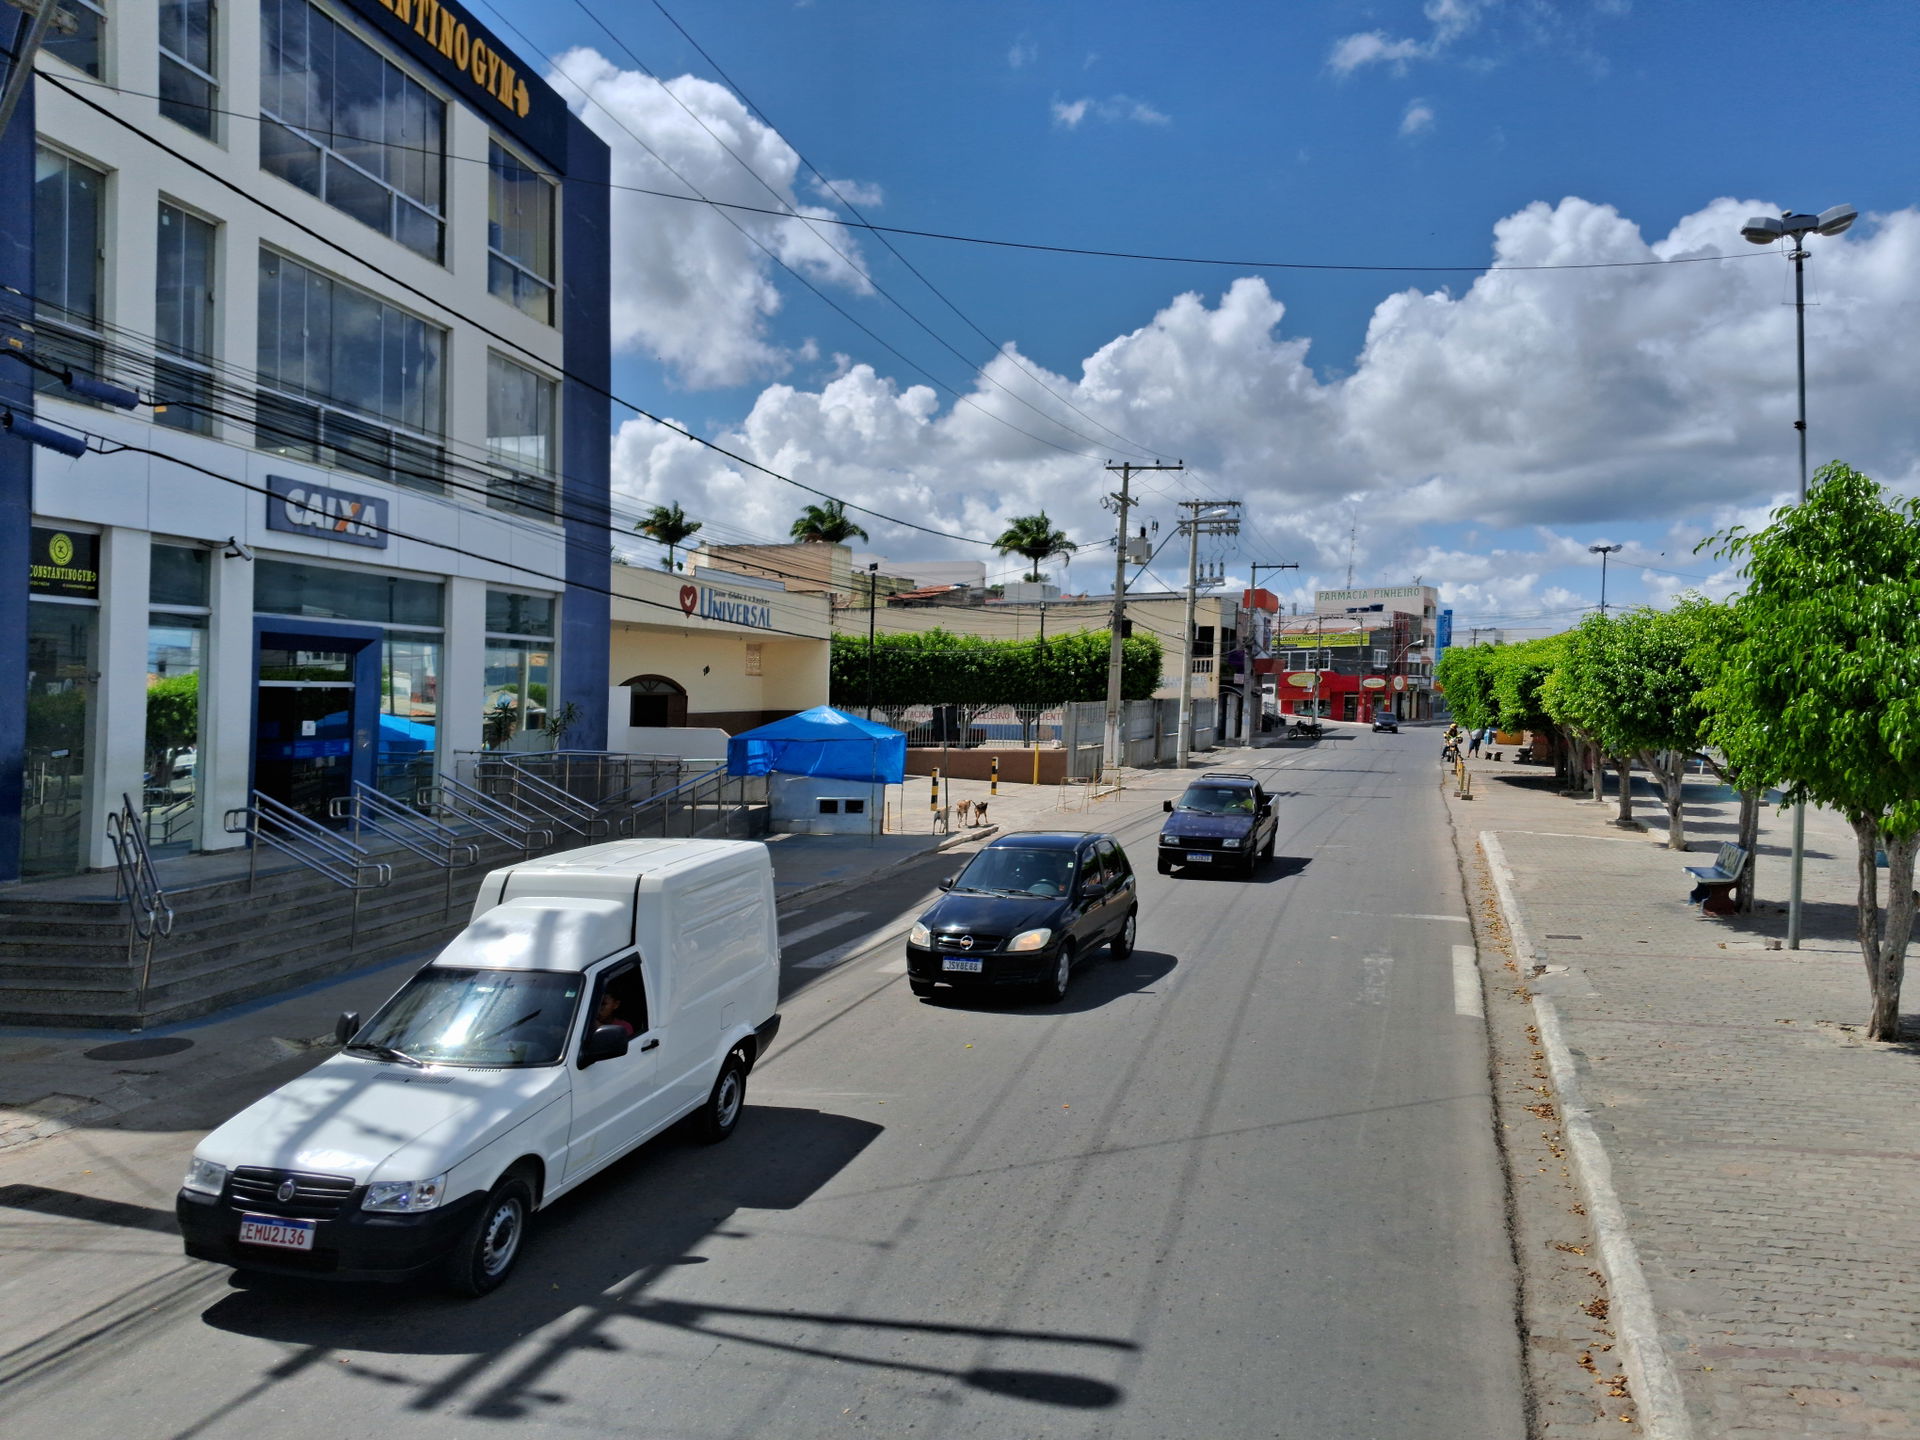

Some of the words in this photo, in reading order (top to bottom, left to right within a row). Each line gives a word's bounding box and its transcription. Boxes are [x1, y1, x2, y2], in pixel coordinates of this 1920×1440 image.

[378, 0, 517, 112] NTINOGYM
[285, 488, 378, 538] CAIXA
[700, 585, 772, 627] UNIVERSAL
[1318, 590, 1369, 601] FARMACIA
[1373, 587, 1420, 599] PINHEIRO
